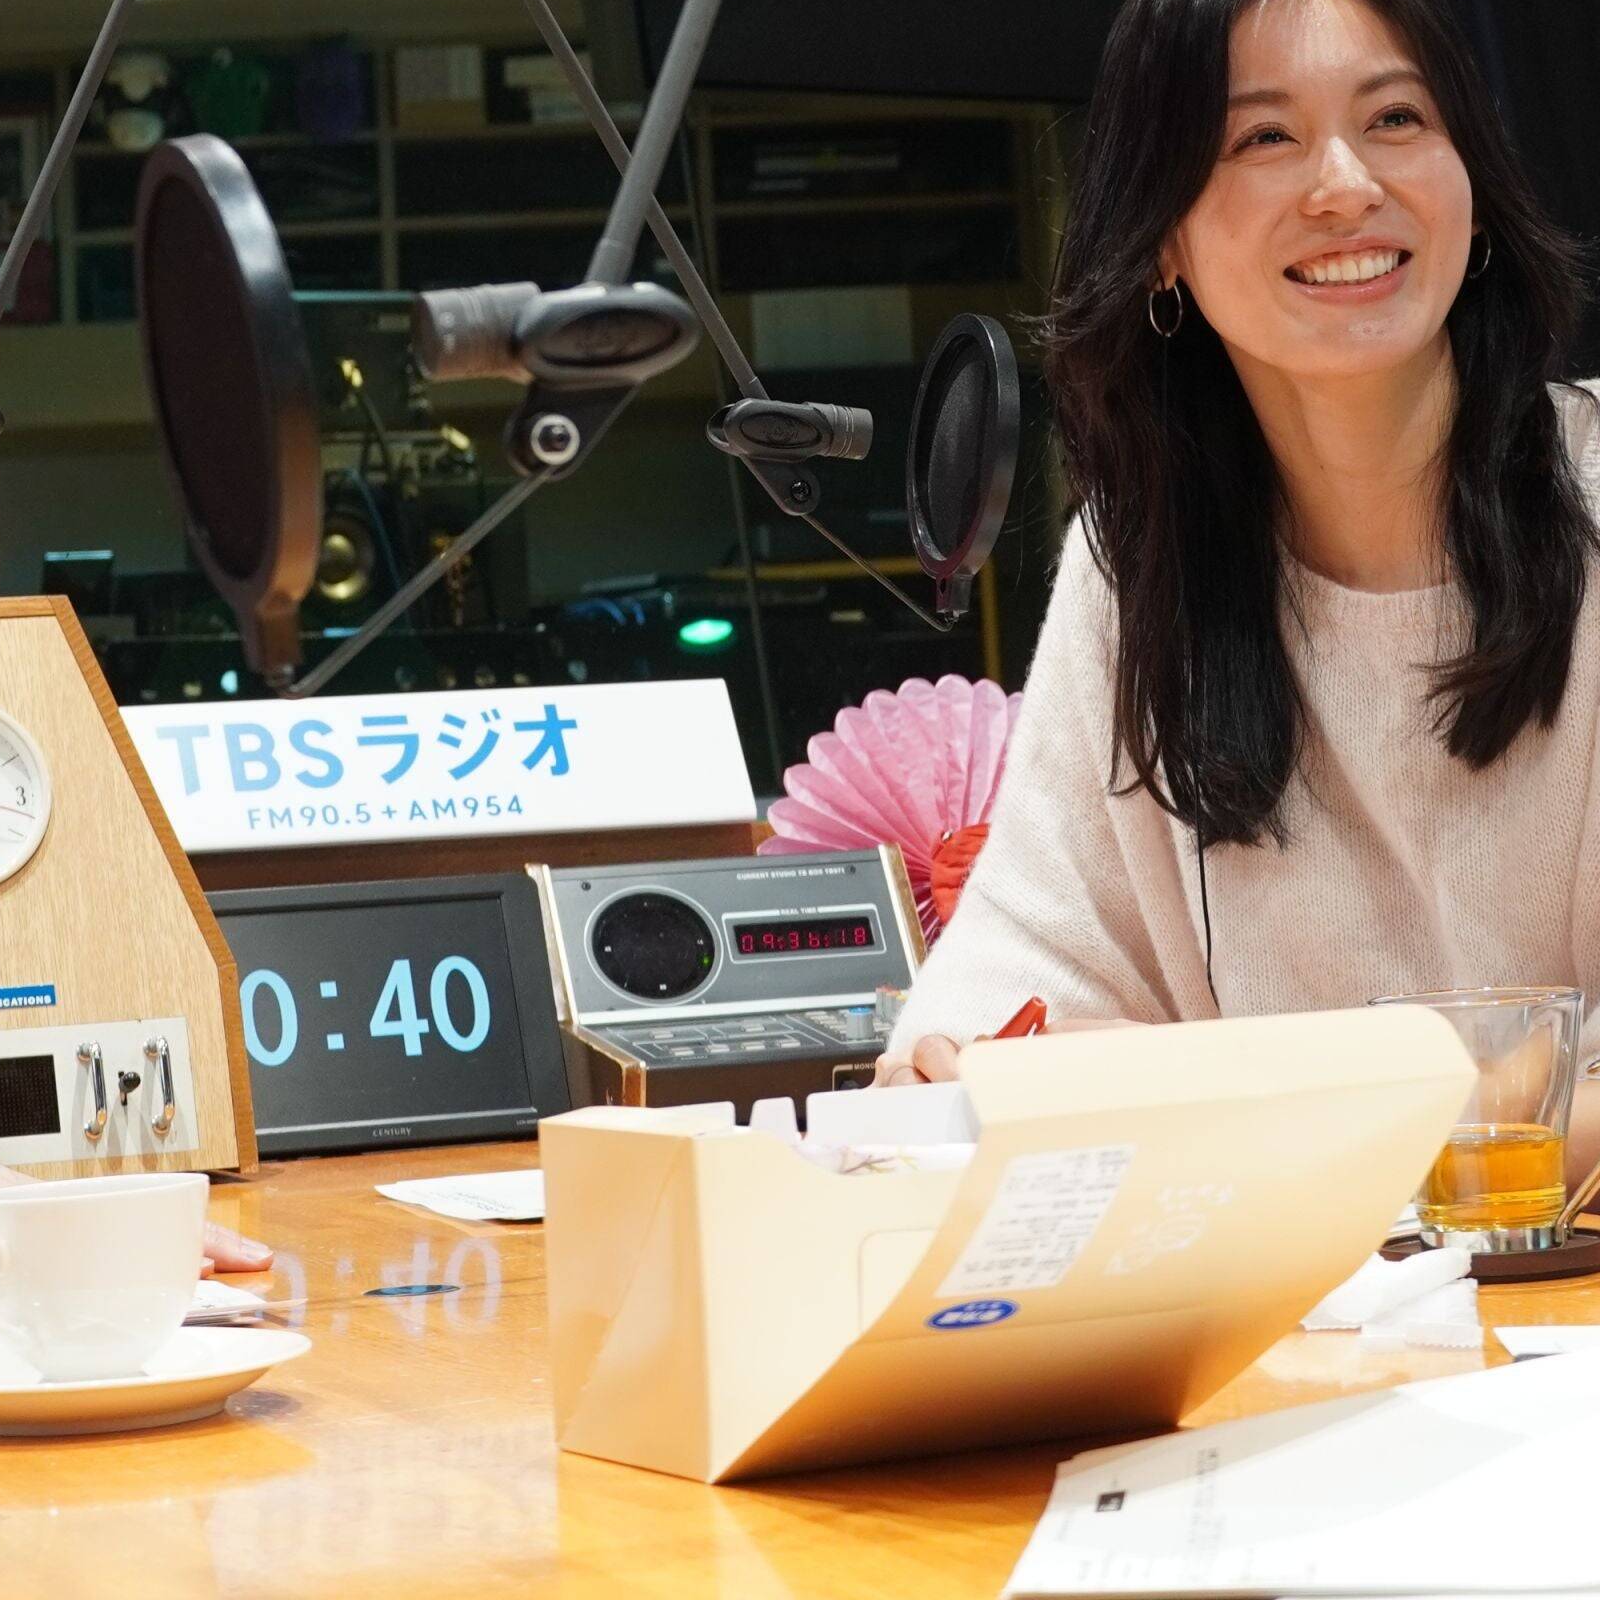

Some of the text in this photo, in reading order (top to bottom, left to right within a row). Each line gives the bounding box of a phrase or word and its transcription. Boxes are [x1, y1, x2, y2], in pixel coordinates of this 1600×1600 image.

[155, 703, 578, 797] TBSラジオ
[15, 786, 27, 806] 3
[372, 1127, 412, 1137] CENTURY
